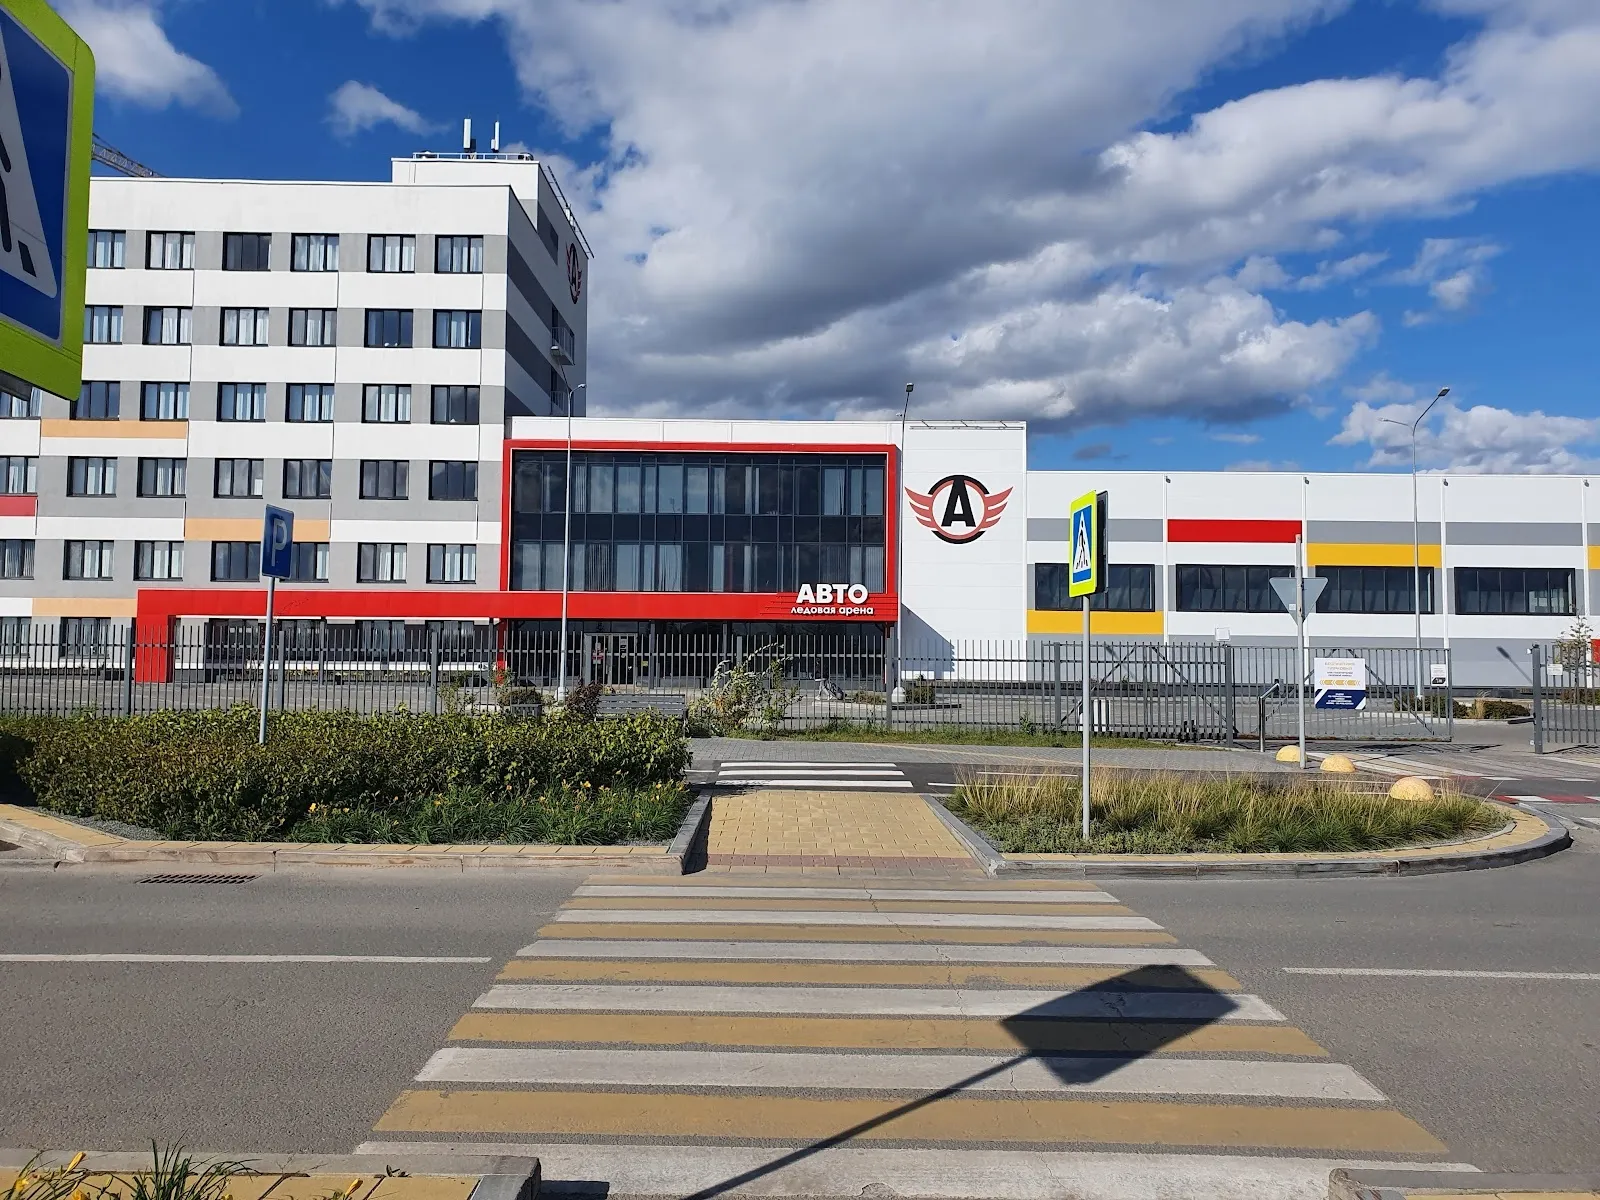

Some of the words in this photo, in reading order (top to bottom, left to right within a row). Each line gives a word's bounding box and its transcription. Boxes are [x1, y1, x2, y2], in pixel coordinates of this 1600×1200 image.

[271, 517, 288, 567] P
[796, 583, 869, 604] АВТО
[791, 607, 836, 615] ледовая
[839, 607, 874, 616] арена
